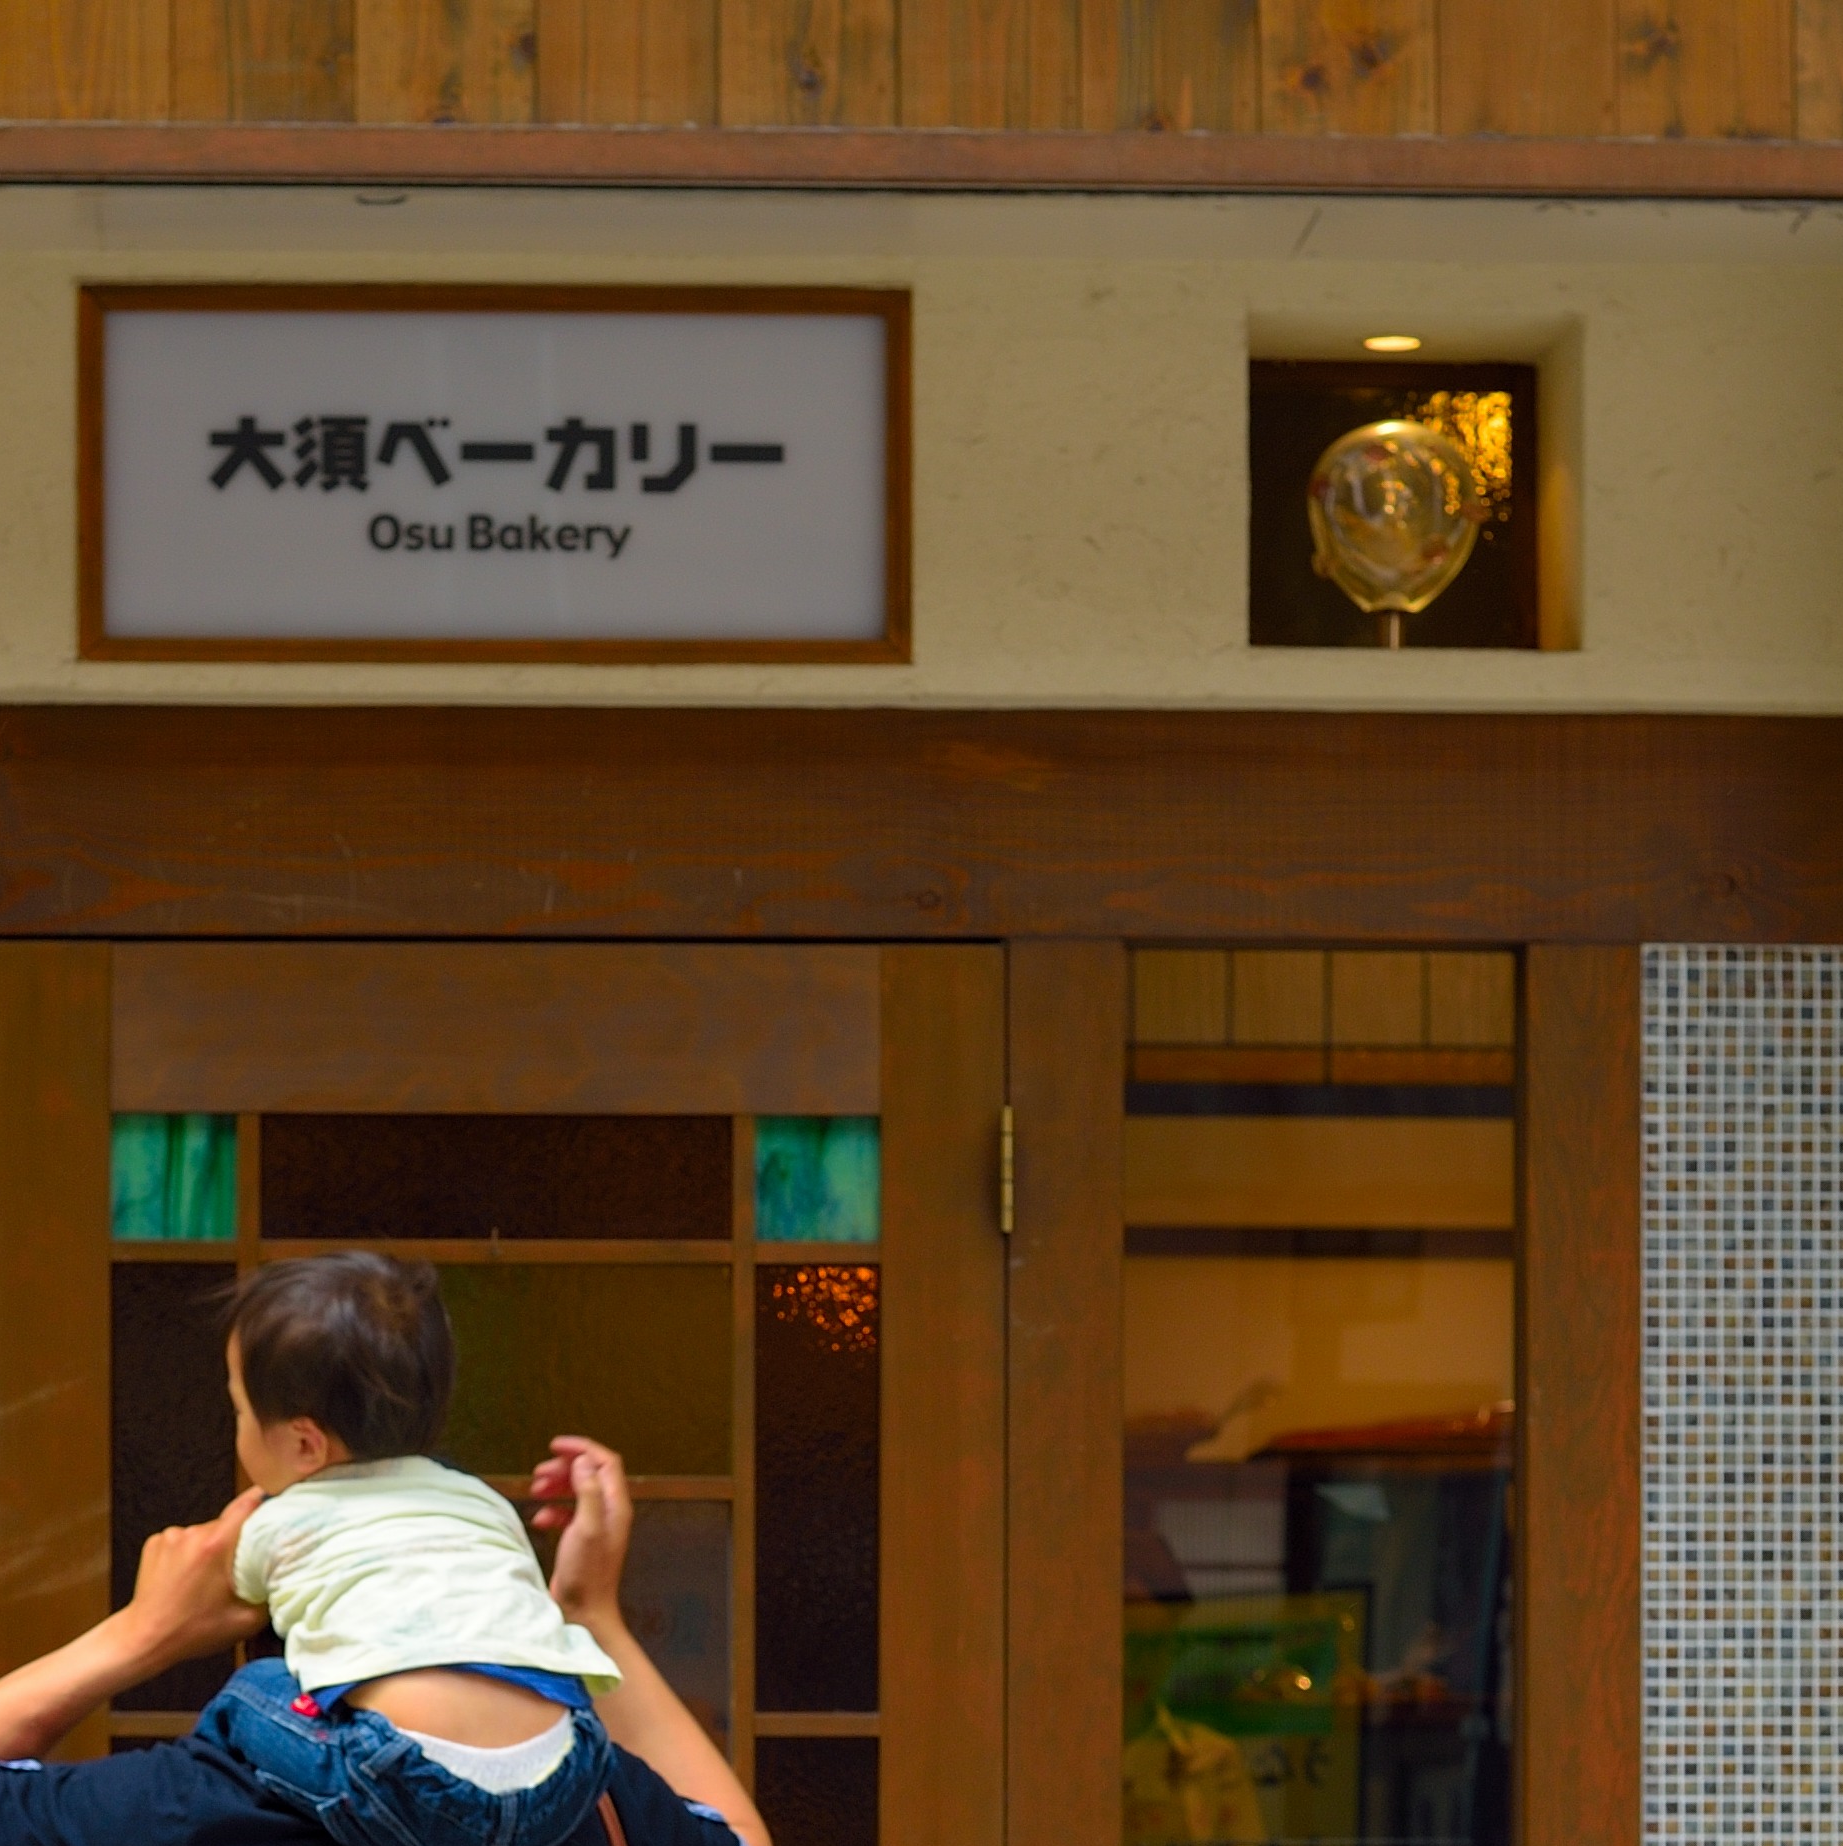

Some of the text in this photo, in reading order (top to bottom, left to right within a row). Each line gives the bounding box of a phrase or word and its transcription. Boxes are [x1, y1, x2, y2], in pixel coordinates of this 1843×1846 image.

[207, 415, 784, 493] 大須ベーカリー
[368, 513, 631, 559] Osu Bakery
